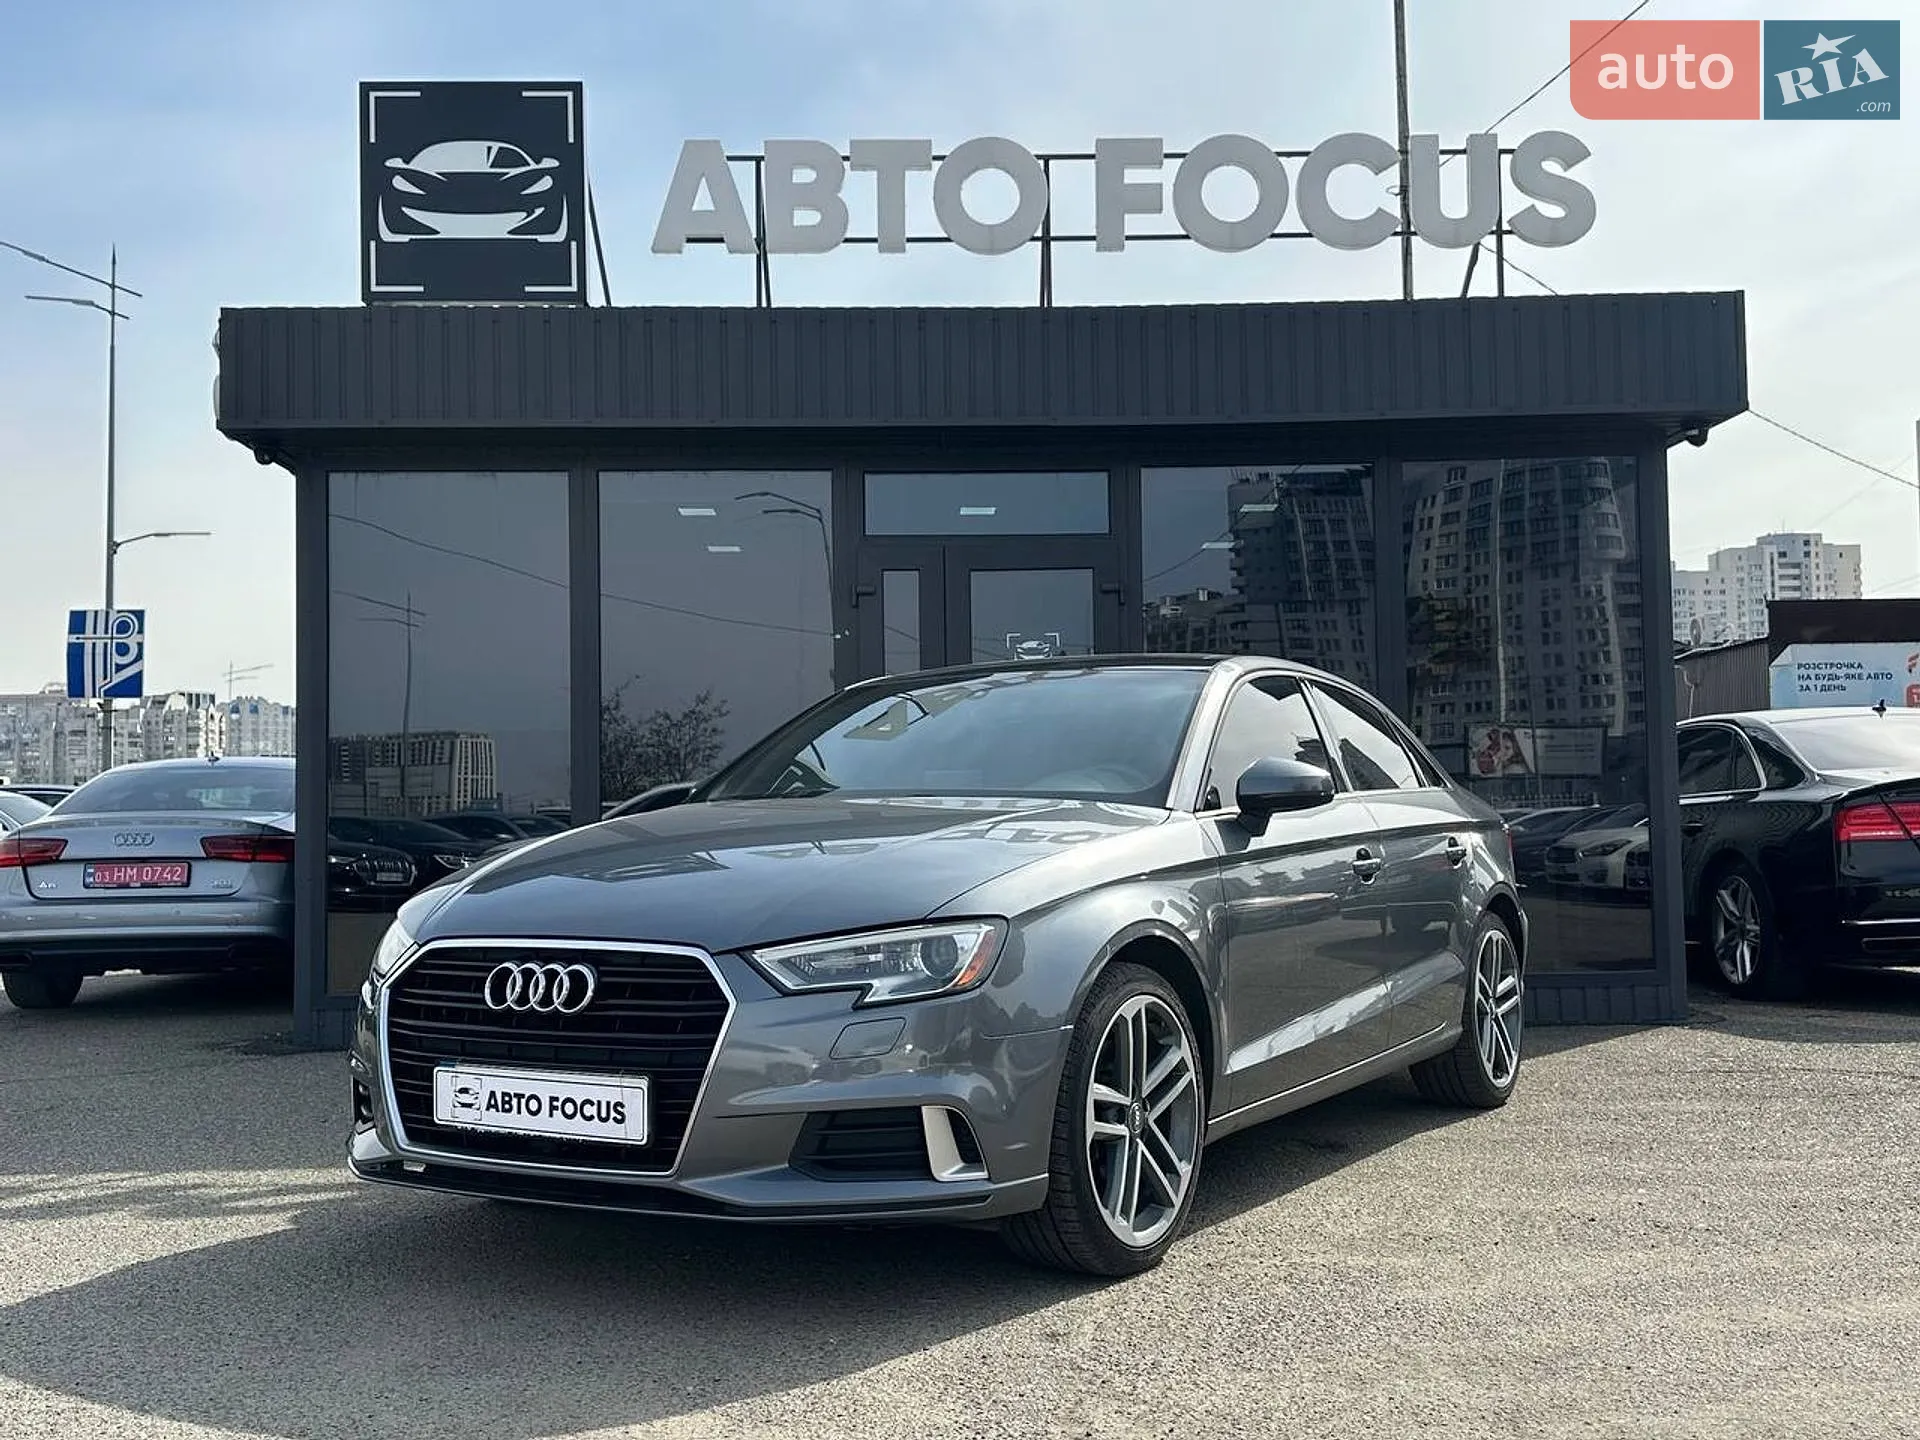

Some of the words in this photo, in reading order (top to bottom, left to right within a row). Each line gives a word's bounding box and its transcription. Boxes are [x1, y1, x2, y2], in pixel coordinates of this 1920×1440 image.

[651, 136, 1049, 256] АВТО
[1095, 130, 1597, 253] FOCUS
[1797, 662, 1863, 670] РОЗСТРОЧКА
[1797, 673, 1812, 681] НА
[1814, 673, 1864, 681] БУДЬ-ЯКЕ
[1866, 672, 1893, 680] АВТО
[1798, 684, 1811, 692] ЗА
[1819, 684, 1847, 693] ДЕНЬ
[142, 866, 182, 881] 0742
[485, 1090, 543, 1117] АВТО
[548, 1096, 627, 1125] FOCUS
